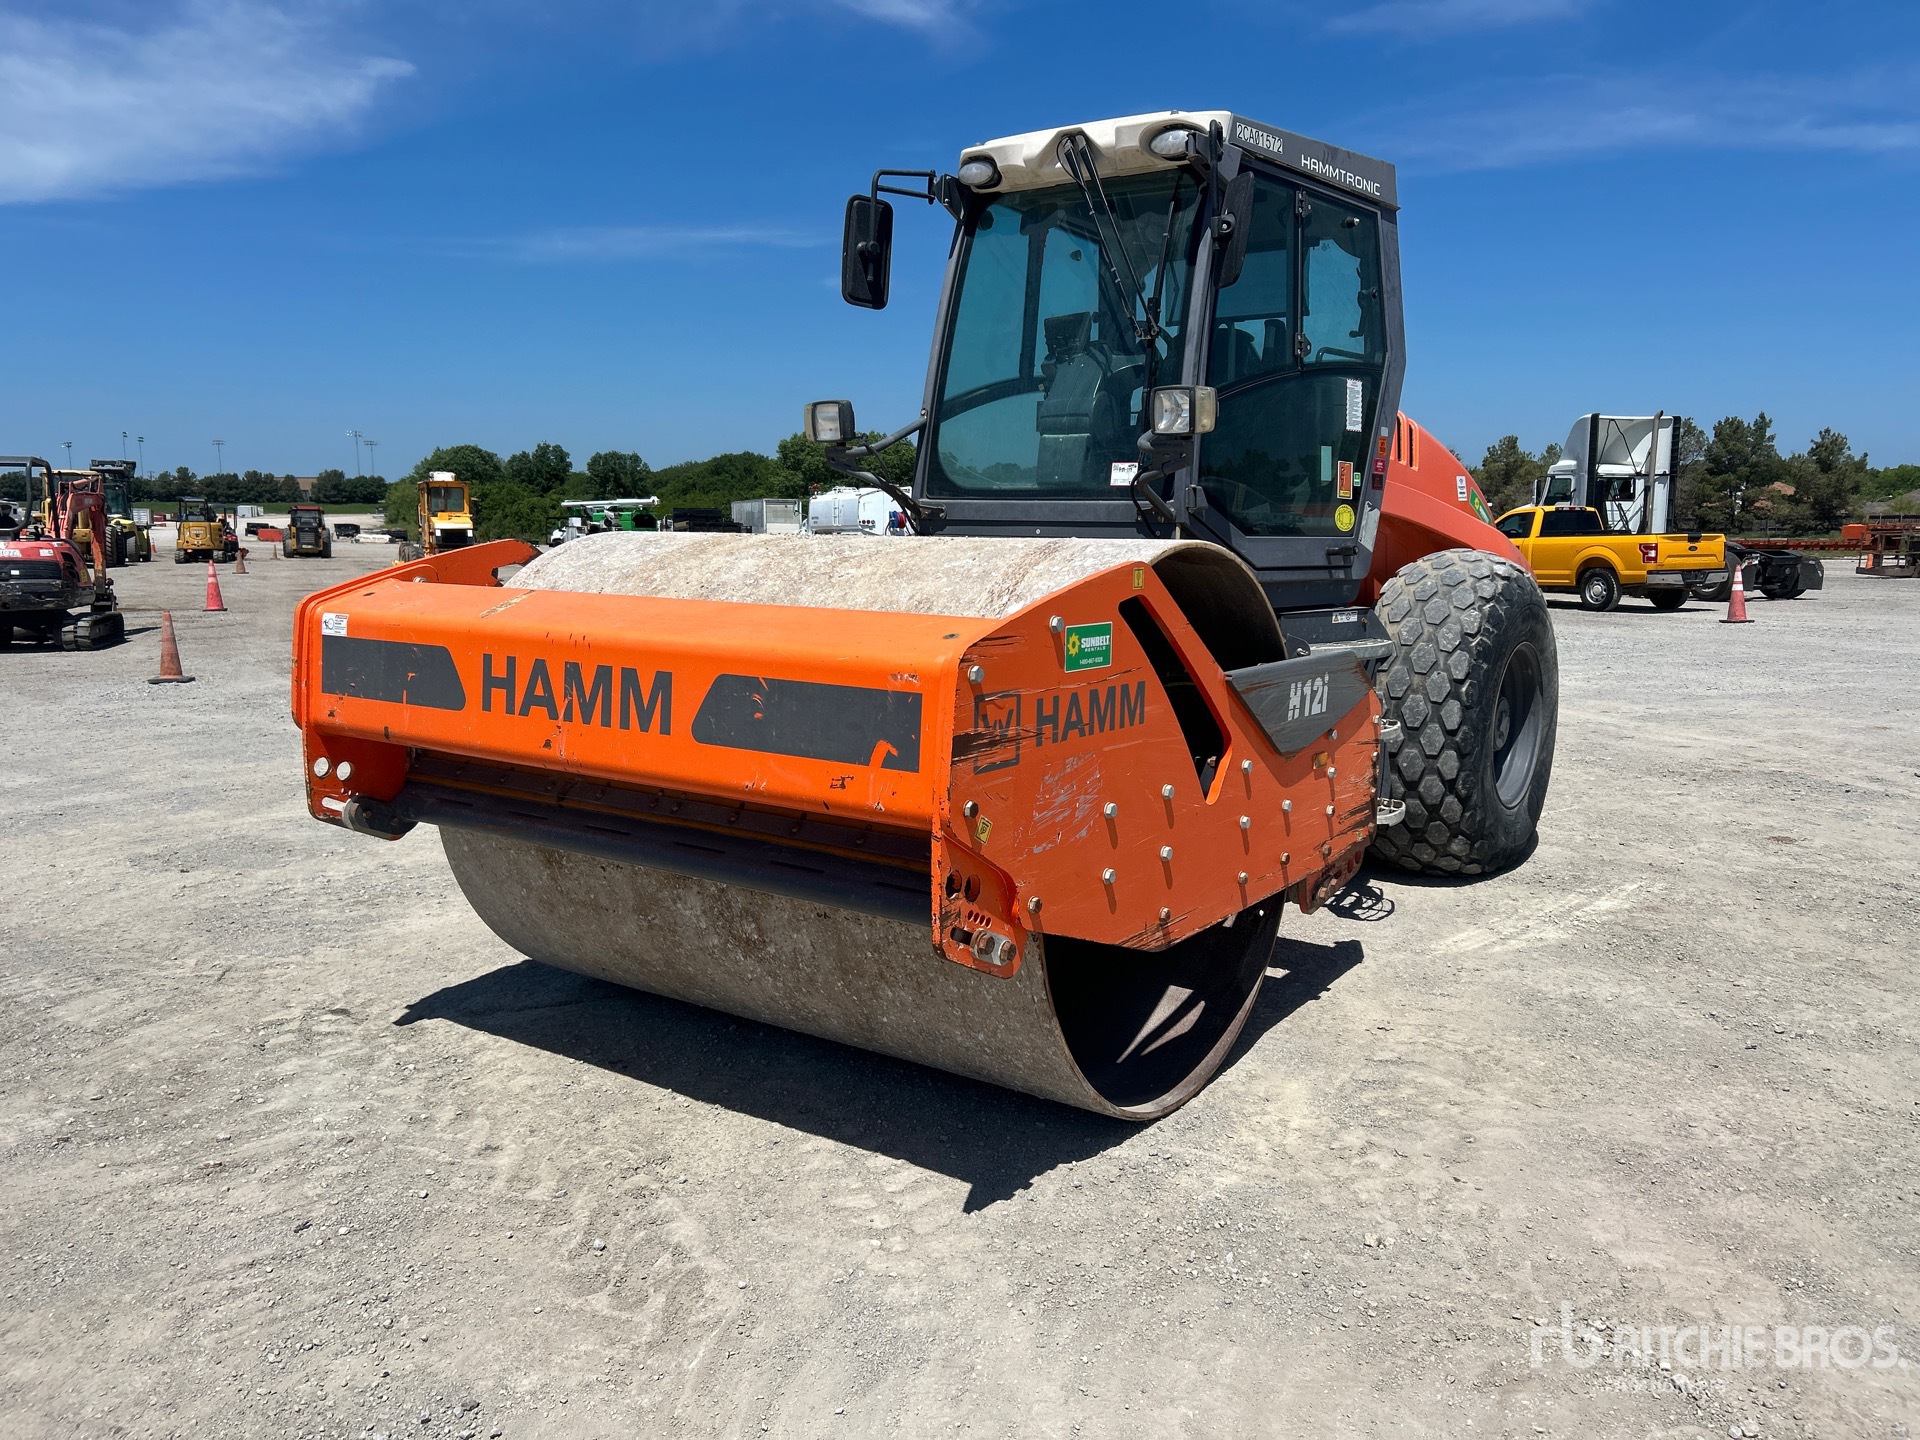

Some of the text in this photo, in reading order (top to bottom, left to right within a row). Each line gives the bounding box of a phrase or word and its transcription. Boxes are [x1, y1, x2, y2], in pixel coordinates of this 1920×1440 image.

[1301, 154, 1381, 196] HAMMTRONIC
[1081, 635, 1110, 648] SUNBELT
[481, 652, 673, 736] HAMM
[1035, 680, 1146, 748] HAMM
[1287, 672, 1330, 721] H12i
